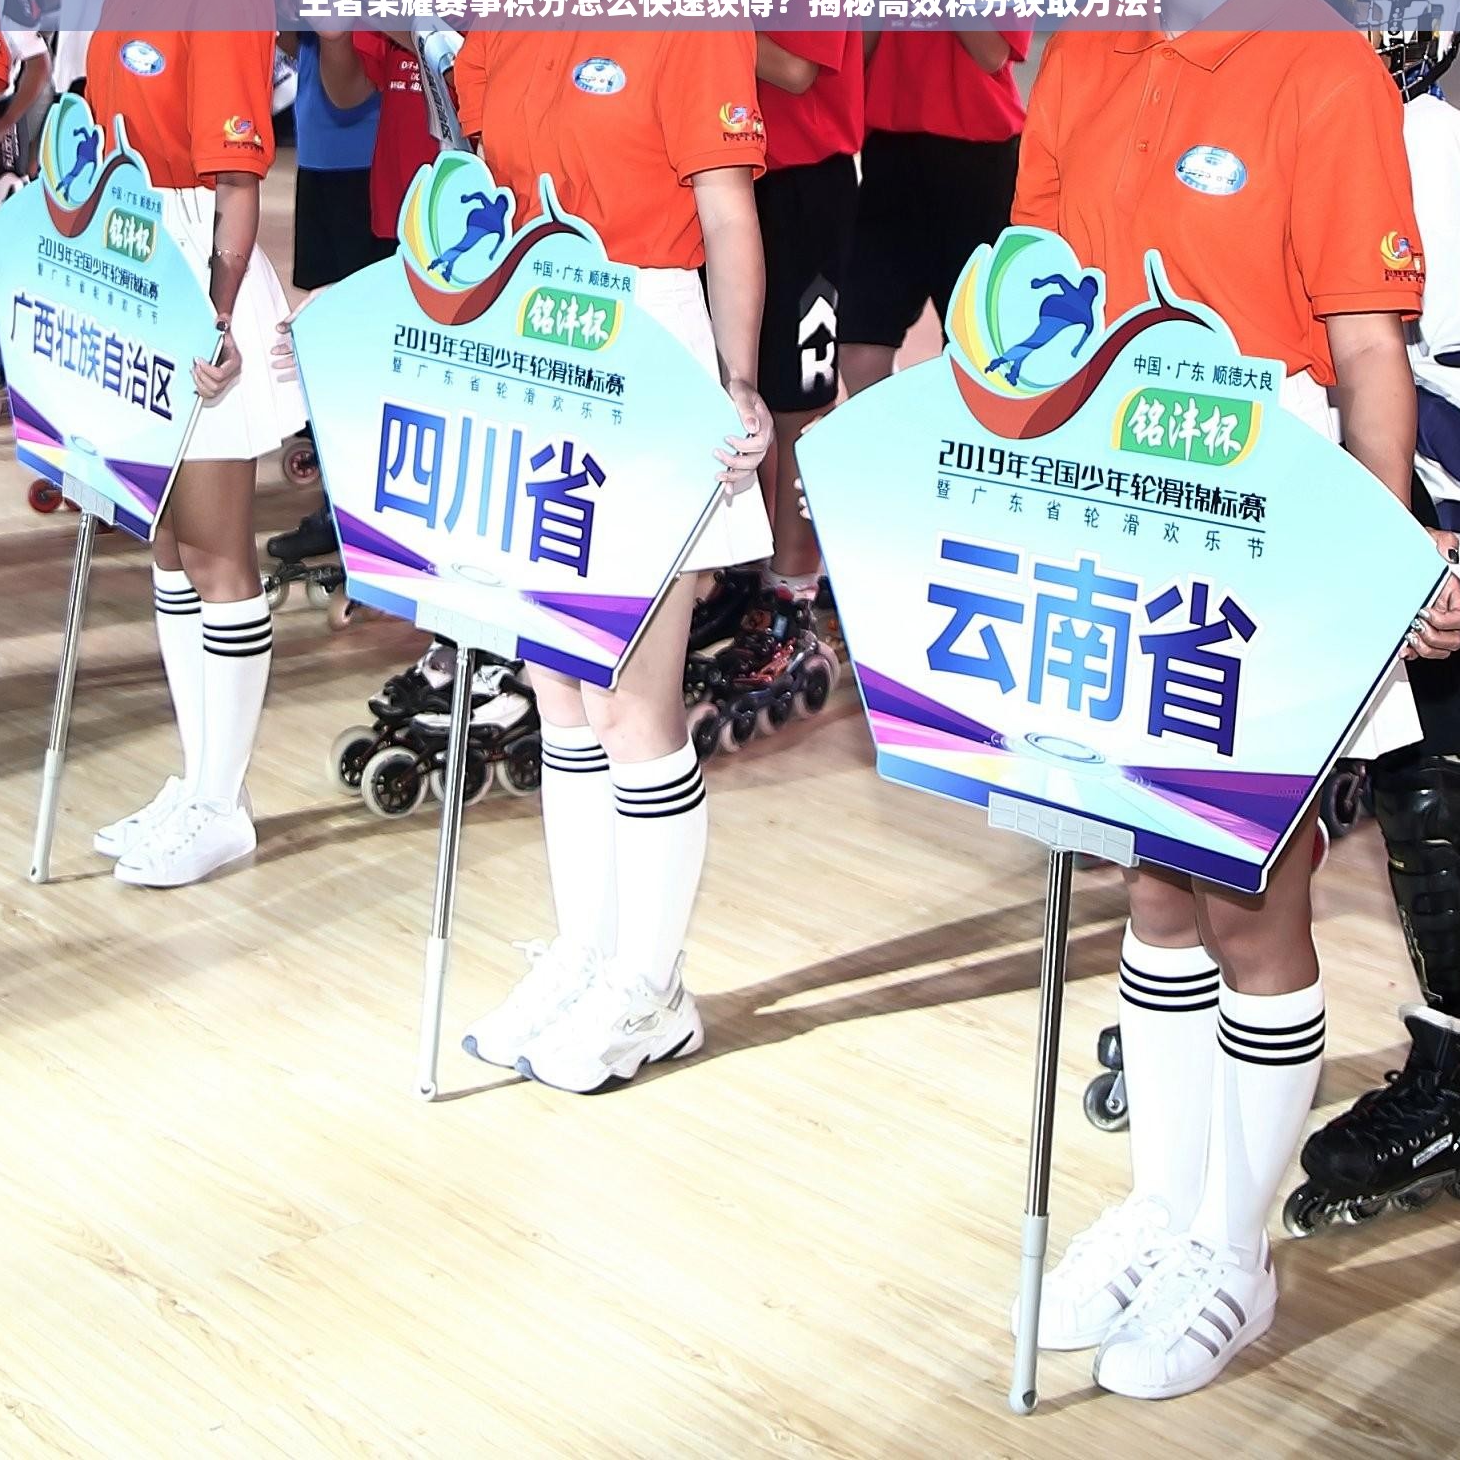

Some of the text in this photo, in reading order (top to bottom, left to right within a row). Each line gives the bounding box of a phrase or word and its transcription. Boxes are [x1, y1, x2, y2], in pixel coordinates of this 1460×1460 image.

[38, 235, 159, 302] 2019年全国少年轮滑锦标赛
[588, 271, 632, 293] 顺德大良
[10, 292, 175, 421] 广西壮族自治区
[526, 292, 610, 349] 铭沣杯
[393, 324, 626, 397] 2019年全国少年轮滑锦标赛
[1212, 365, 1274, 392] 顺德大良
[1126, 395, 1242, 462] 铭沣杯
[375, 401, 606, 578] 四川省
[938, 440, 1268, 523] 2019年全国少年轮滑锦标赛
[935, 479, 1265, 560] 暨广东省轮滑欢乐节
[926, 538, 1259, 756] 云南省
